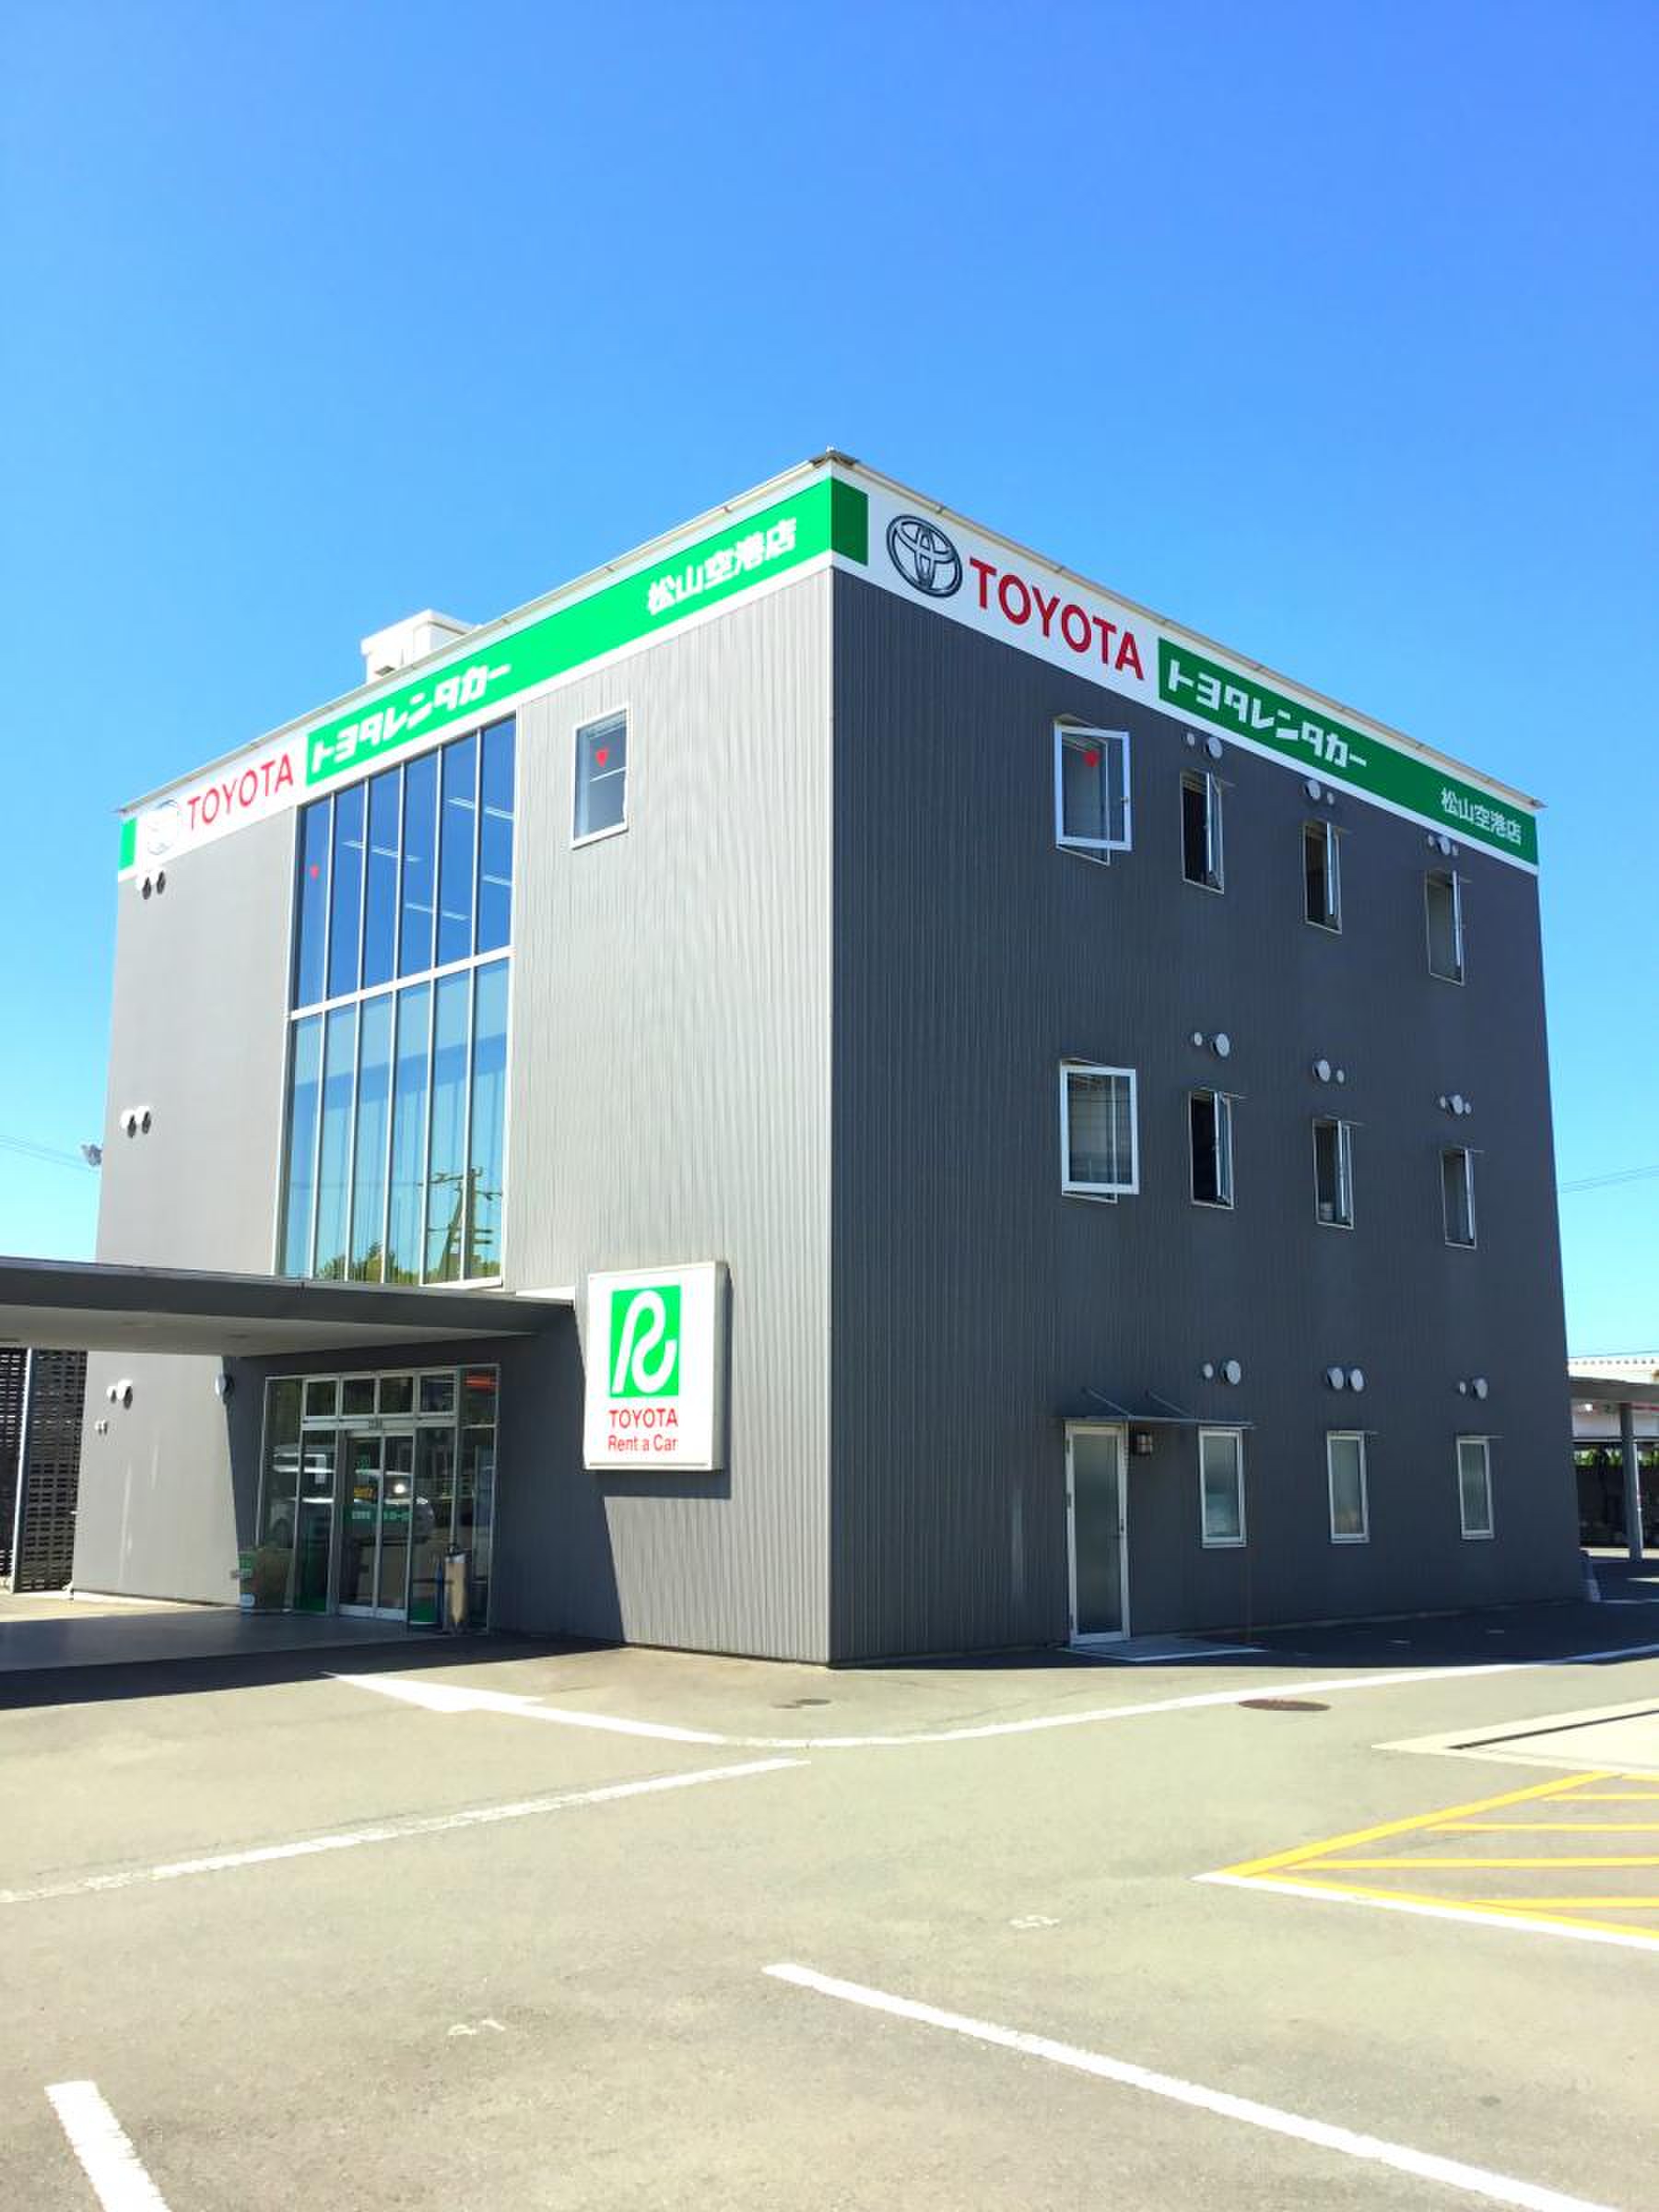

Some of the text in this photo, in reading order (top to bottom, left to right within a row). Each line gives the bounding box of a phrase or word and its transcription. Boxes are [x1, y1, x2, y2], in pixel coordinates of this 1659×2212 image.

[187, 517, 797, 831] TOYOTA トヨタレンタカー 松山空港店
[969, 557, 1522, 846] TOYOTA トヨタレンタカー 松山空港店
[608, 1408, 678, 1429] TOYOTA
[608, 1433, 678, 1452] Rent a Car
